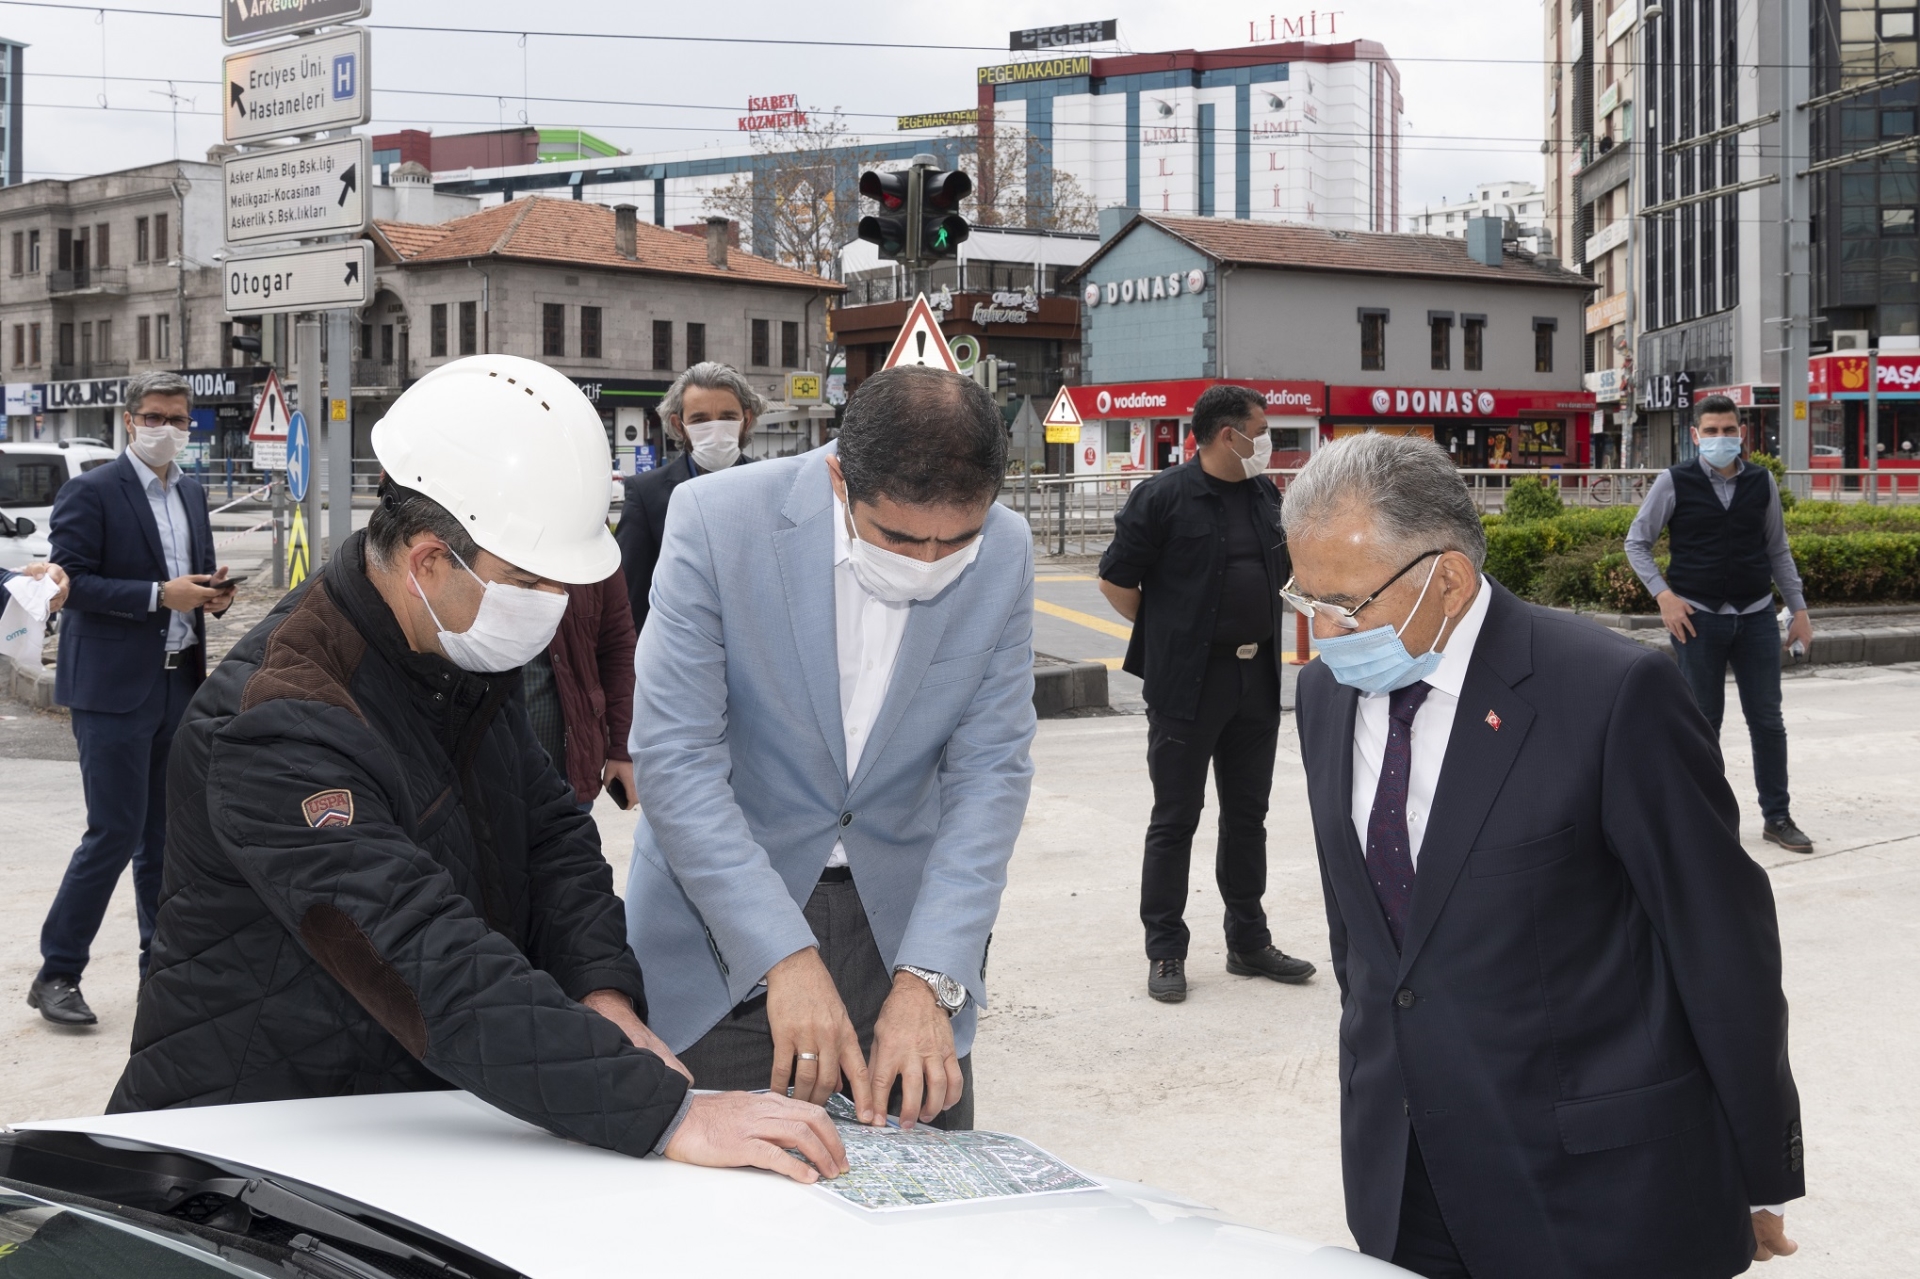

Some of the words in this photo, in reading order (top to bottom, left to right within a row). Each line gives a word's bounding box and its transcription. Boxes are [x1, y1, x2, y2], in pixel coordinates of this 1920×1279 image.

[1249, 10, 1344, 43] LİMİT
[250, 66, 296, 89] Erciyes
[301, 54, 326, 79] Üni.
[978, 56, 1089, 84] PEGEMAKADEMİ
[250, 88, 325, 121] Hastaneleri
[748, 93, 796, 112] İSABEY
[738, 108, 809, 132] KOZMETİK
[230, 170, 254, 185] Asker
[257, 166, 279, 181] Alma
[231, 184, 321, 208] Melikgazi-Kocasinan
[231, 211, 266, 229] Askerlik
[231, 271, 293, 299] Otogar
[1114, 391, 1167, 409] vodafone
[1262, 389, 1312, 405] dafone
[1645, 375, 1672, 409] ALB
[308, 793, 348, 813] USPA
